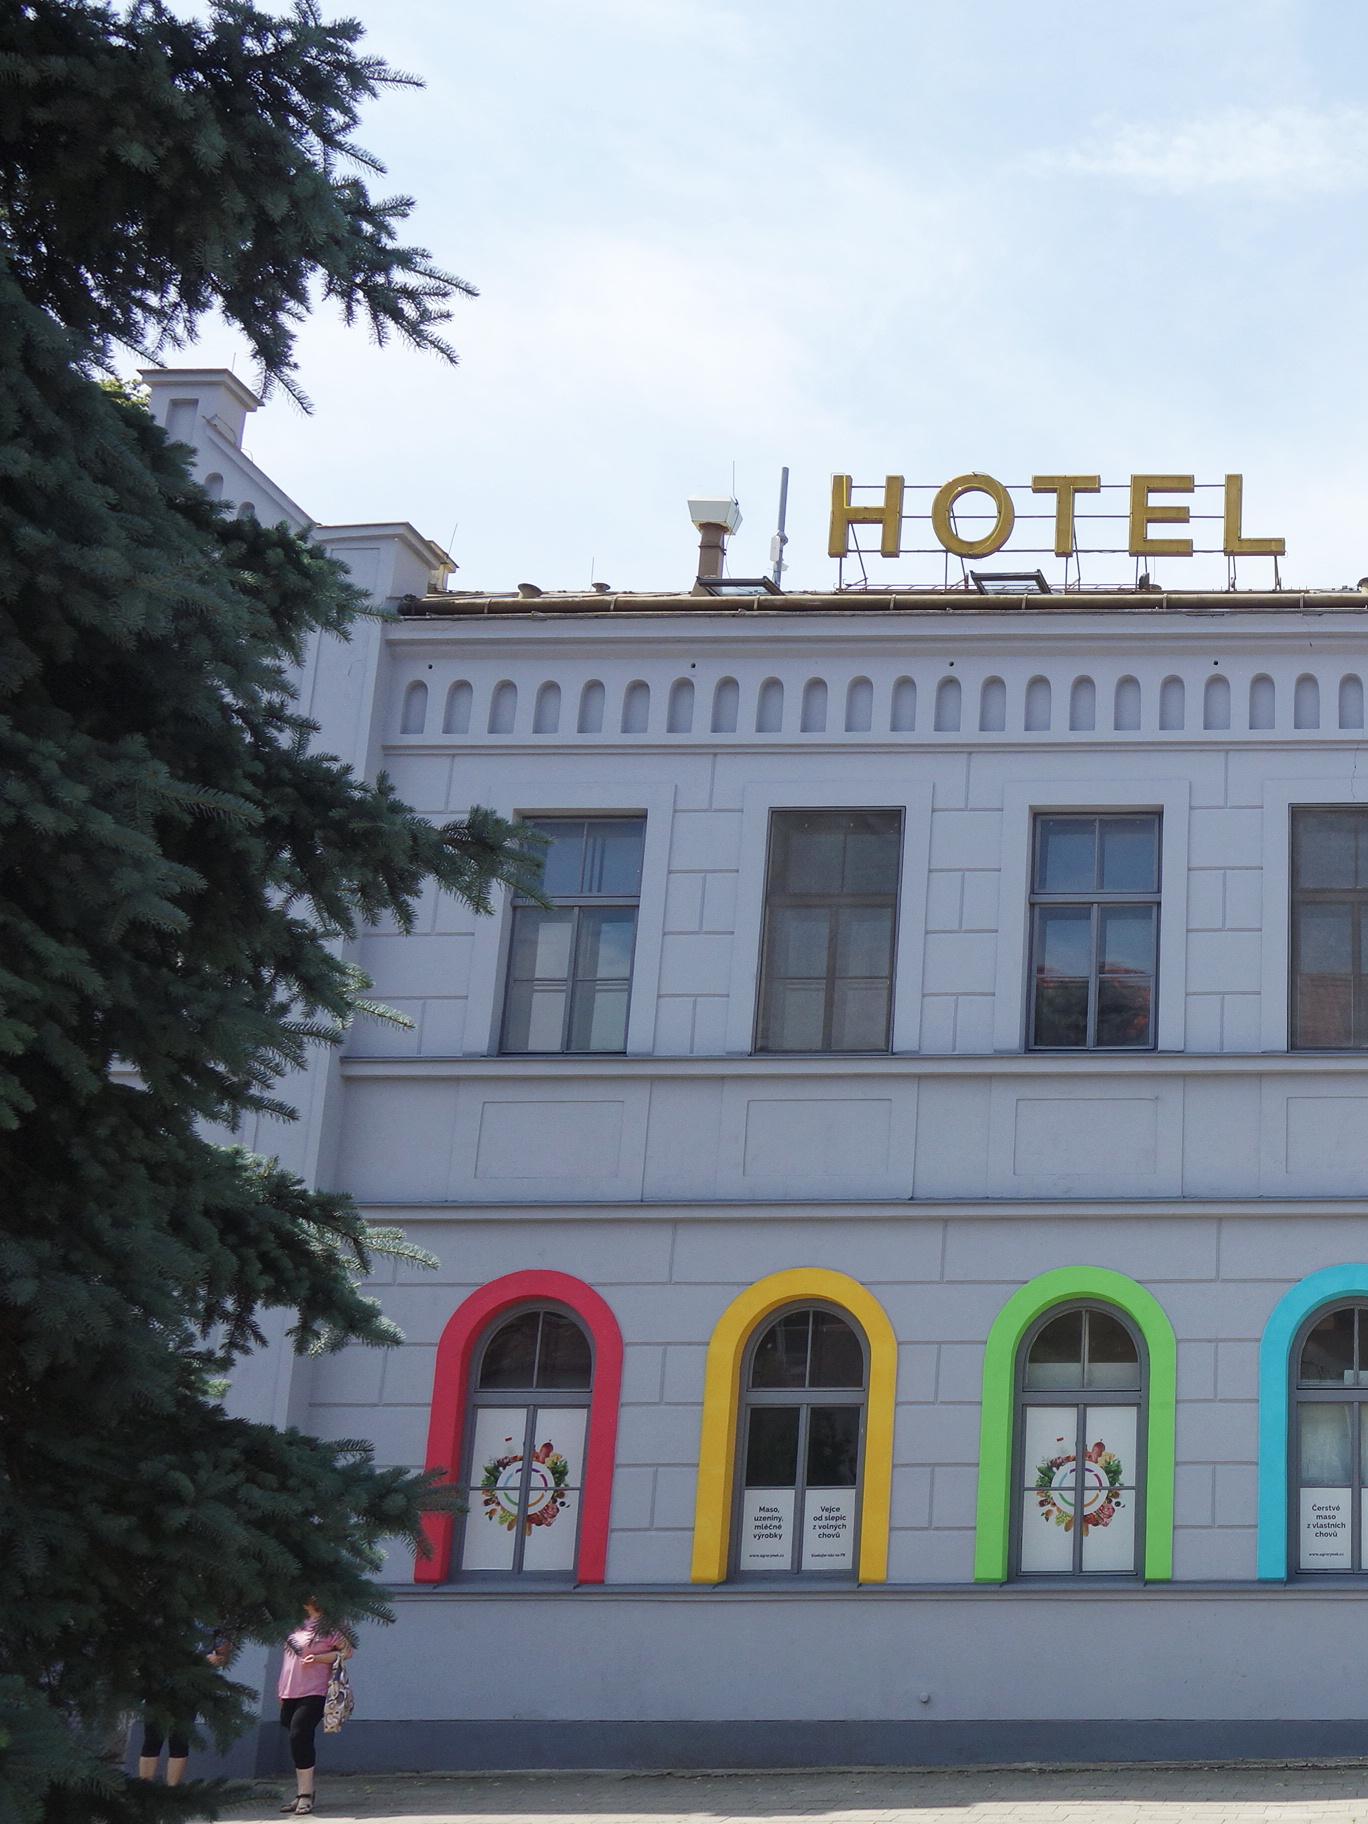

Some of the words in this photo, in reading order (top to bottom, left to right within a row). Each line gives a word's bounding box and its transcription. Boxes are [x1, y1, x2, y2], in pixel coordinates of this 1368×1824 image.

[827, 471, 1286, 559] HOTEL
[758, 1505, 780, 1514] Maso,
[820, 1505, 841, 1514] Vejce
[1311, 1504, 1341, 1512] Čerstvé
[753, 1514, 784, 1523] uzeniny,
[813, 1514, 823, 1522] od
[824, 1514, 847, 1523] slepic
[754, 1523, 783, 1531] mléčné
[818, 1523, 847, 1531] volných
[753, 1532, 783, 1541] výrobky
[818, 1531, 841, 1539] chovů
[1314, 1530, 1338, 1538] chovů
